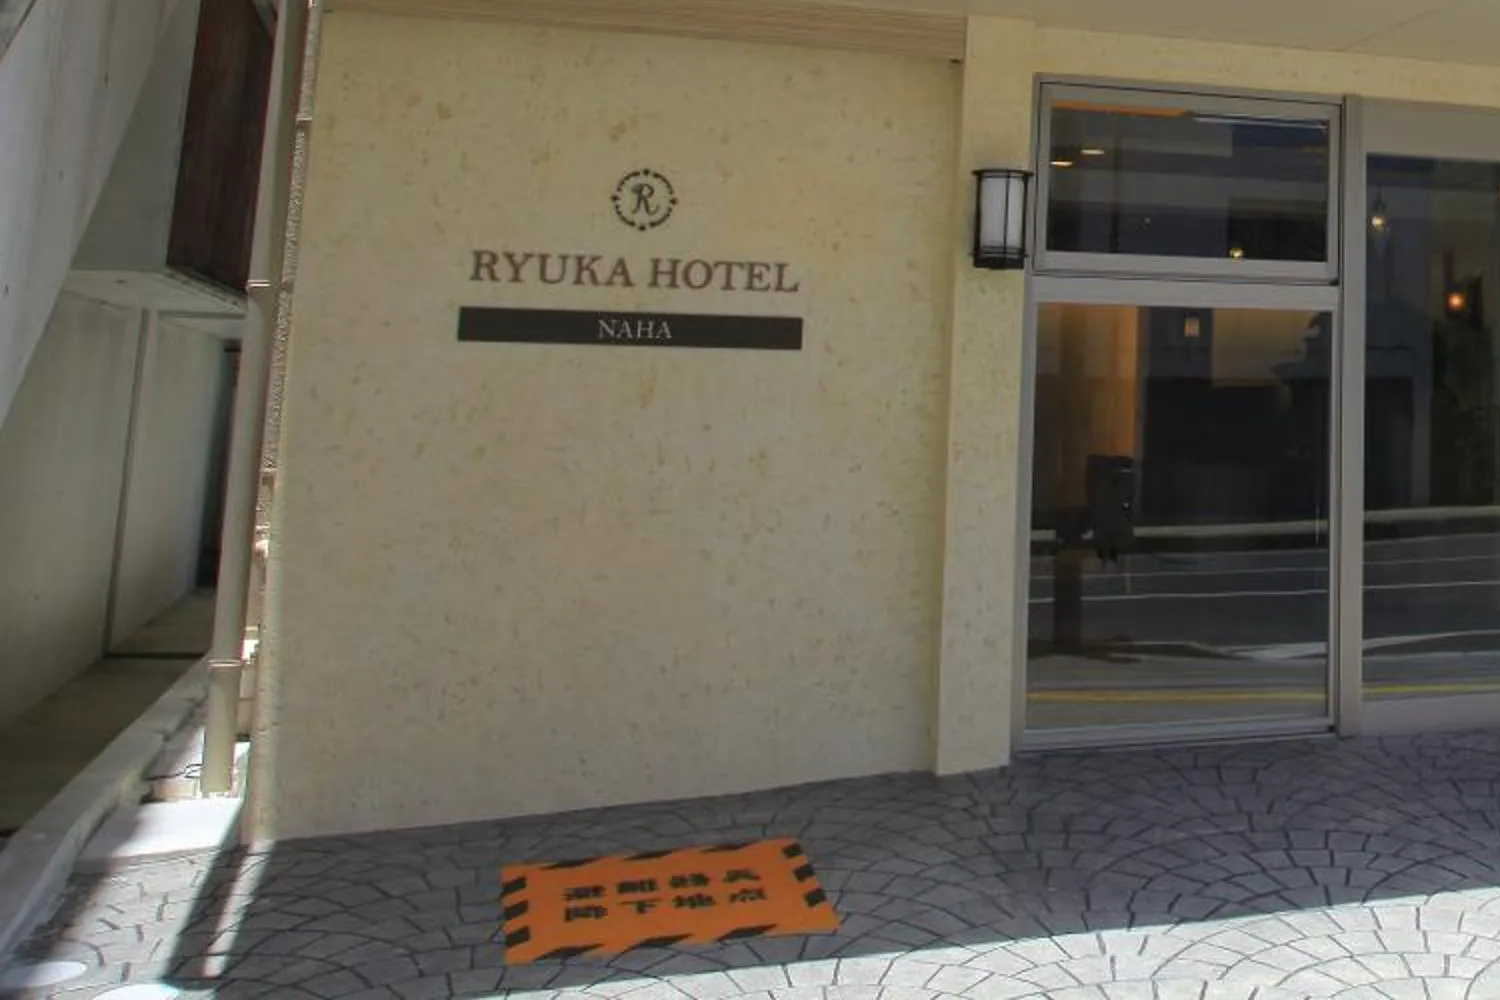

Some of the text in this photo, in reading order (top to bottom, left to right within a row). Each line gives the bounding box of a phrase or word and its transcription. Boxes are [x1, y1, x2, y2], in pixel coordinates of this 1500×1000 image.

[469, 249, 800, 293] RYUKA HOTEL
[597, 318, 673, 340] NAHA
